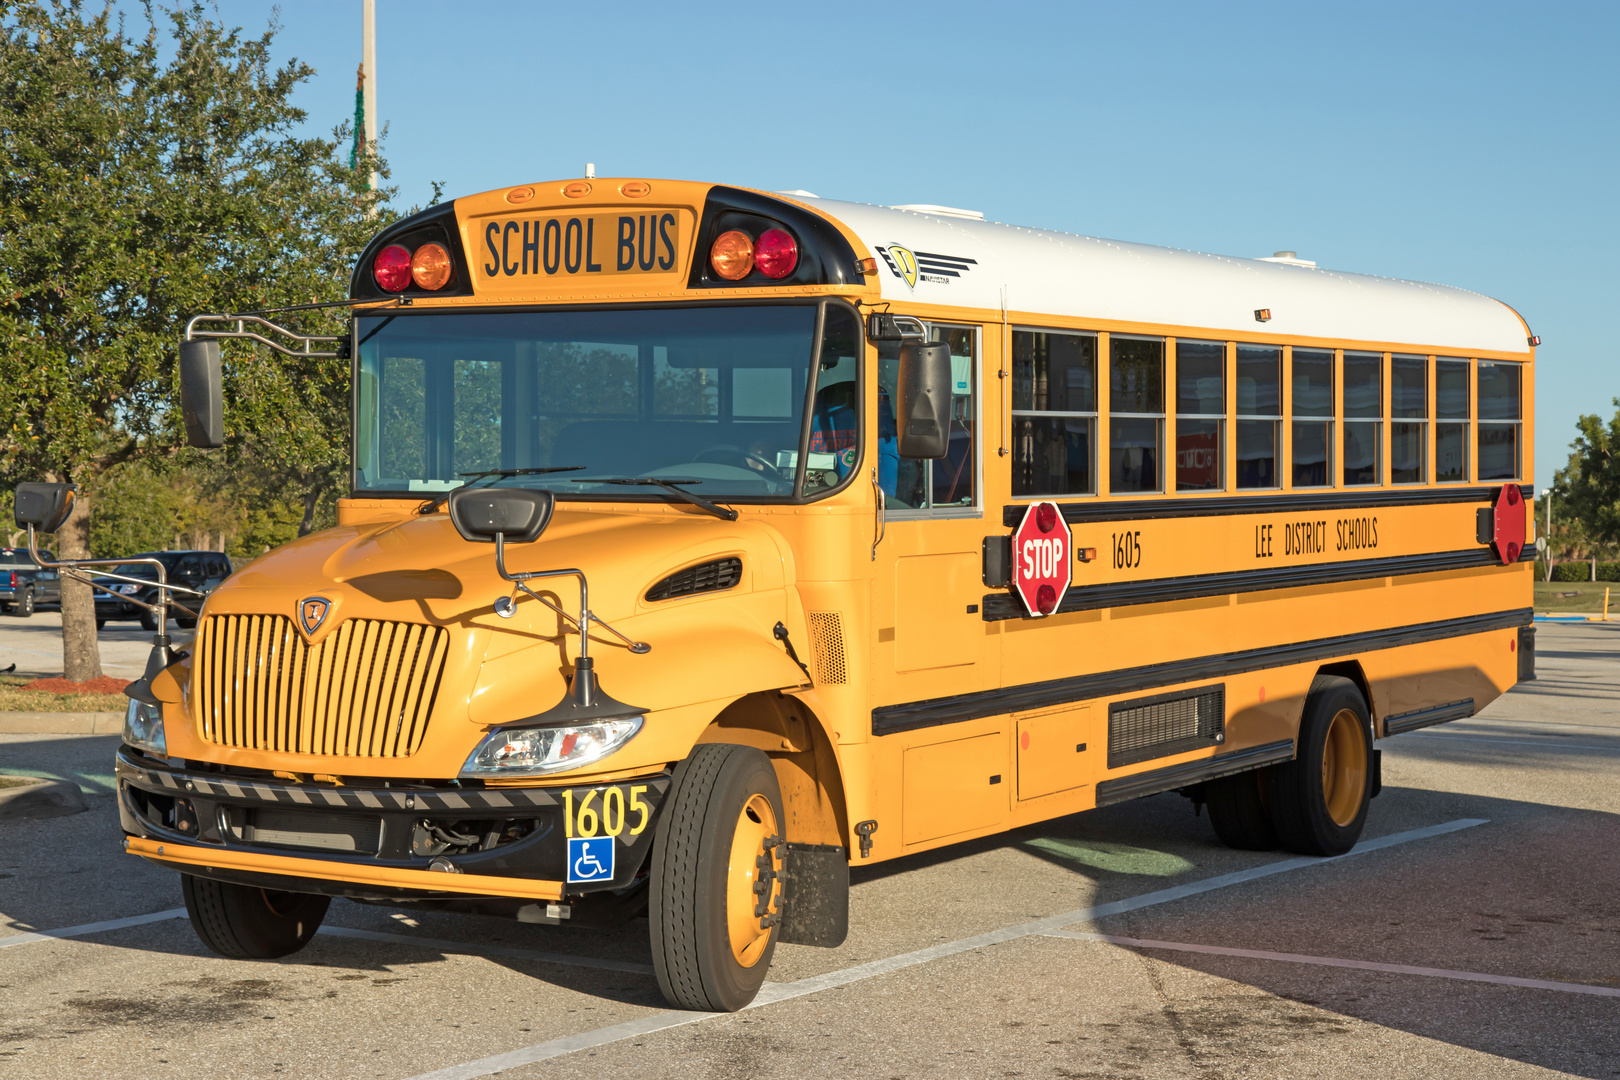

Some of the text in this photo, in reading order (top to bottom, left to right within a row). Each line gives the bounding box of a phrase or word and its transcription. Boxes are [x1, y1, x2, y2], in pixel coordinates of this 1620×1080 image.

[485, 212, 676, 277] SCHOOL BUS
[1112, 532, 1141, 569] 1605
[1255, 517, 1378, 558] LEE DISTRICT SCHOOLS
[1022, 538, 1063, 581] STOP
[561, 785, 649, 838] 1605
